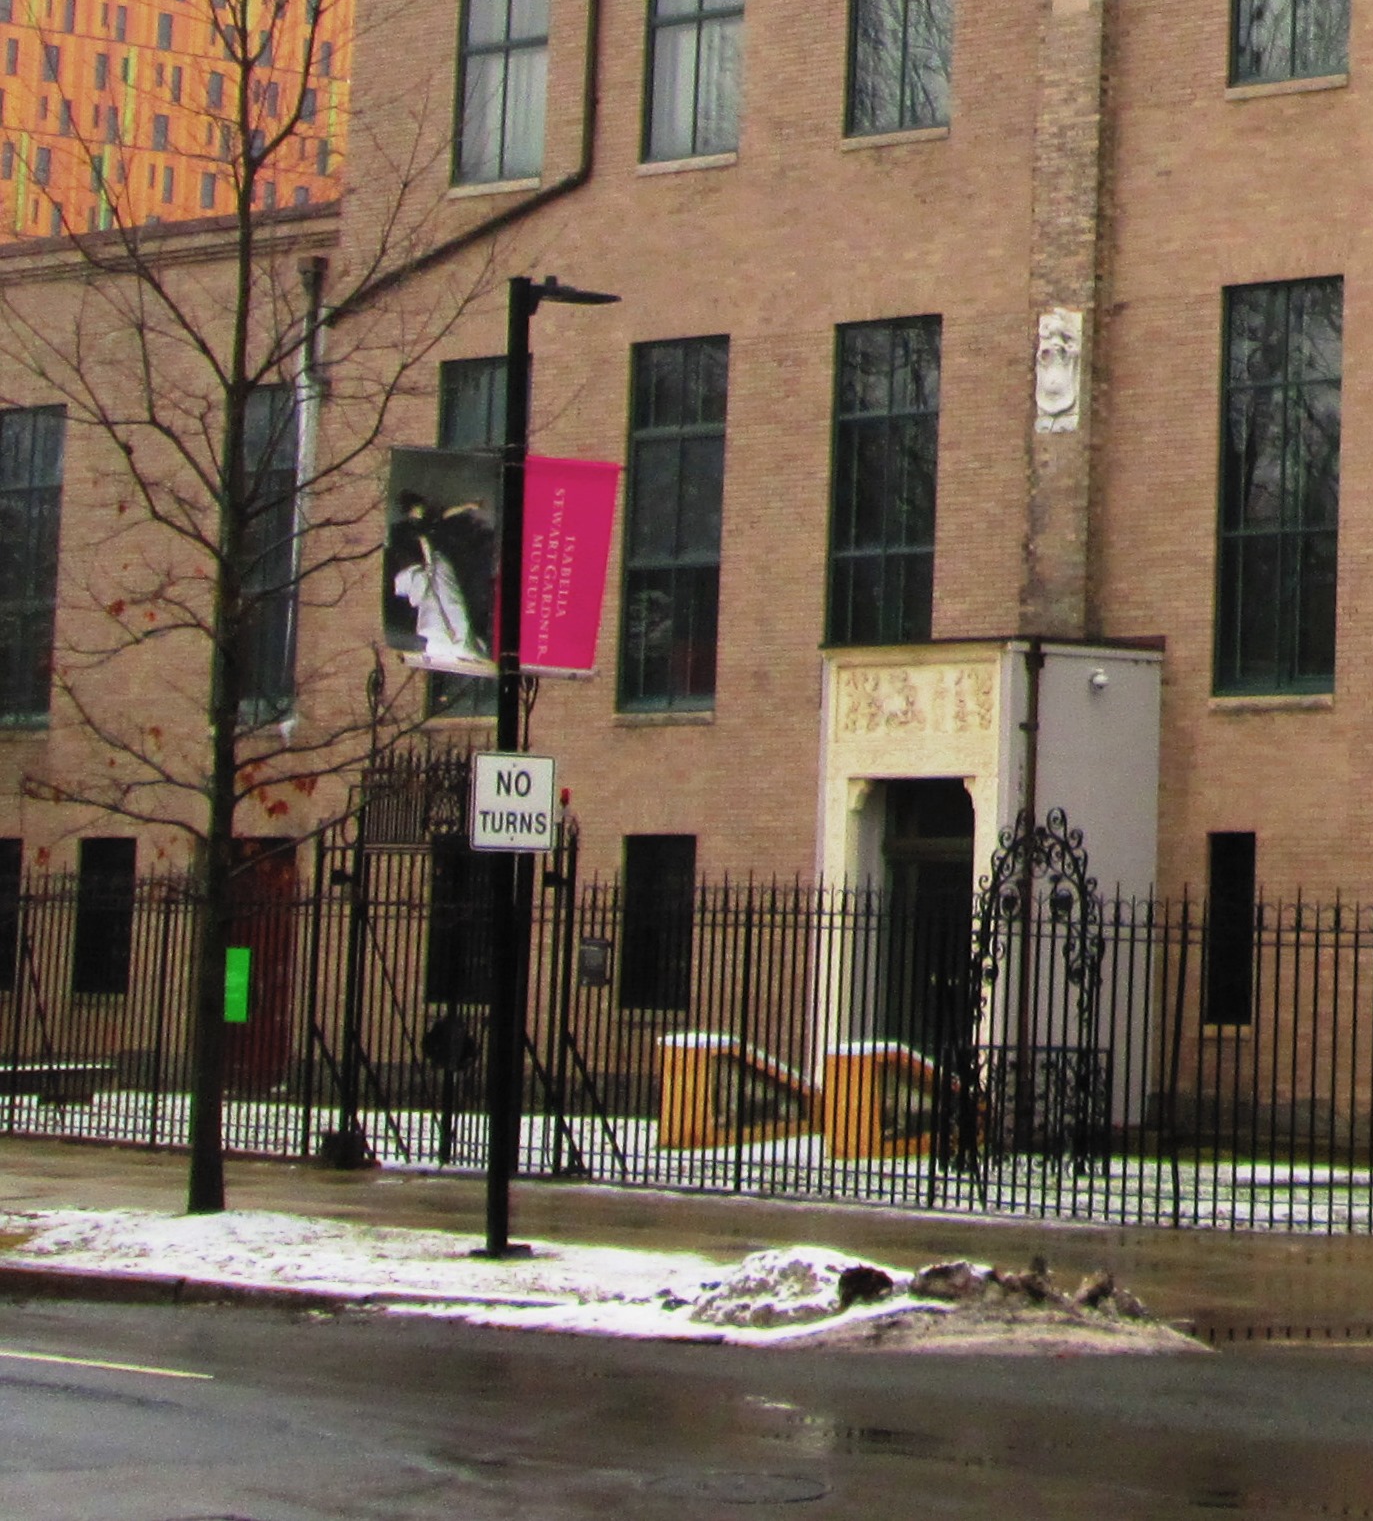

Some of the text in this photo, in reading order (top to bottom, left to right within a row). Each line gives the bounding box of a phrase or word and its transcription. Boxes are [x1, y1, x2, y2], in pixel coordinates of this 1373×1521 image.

[525, 534, 545, 616] MUSEUM
[537, 487, 566, 662] STEWART GARDNER
[555, 535, 576, 618] ISABELLA
[479, 810, 547, 835] TURNS
[496, 769, 531, 797] NO
